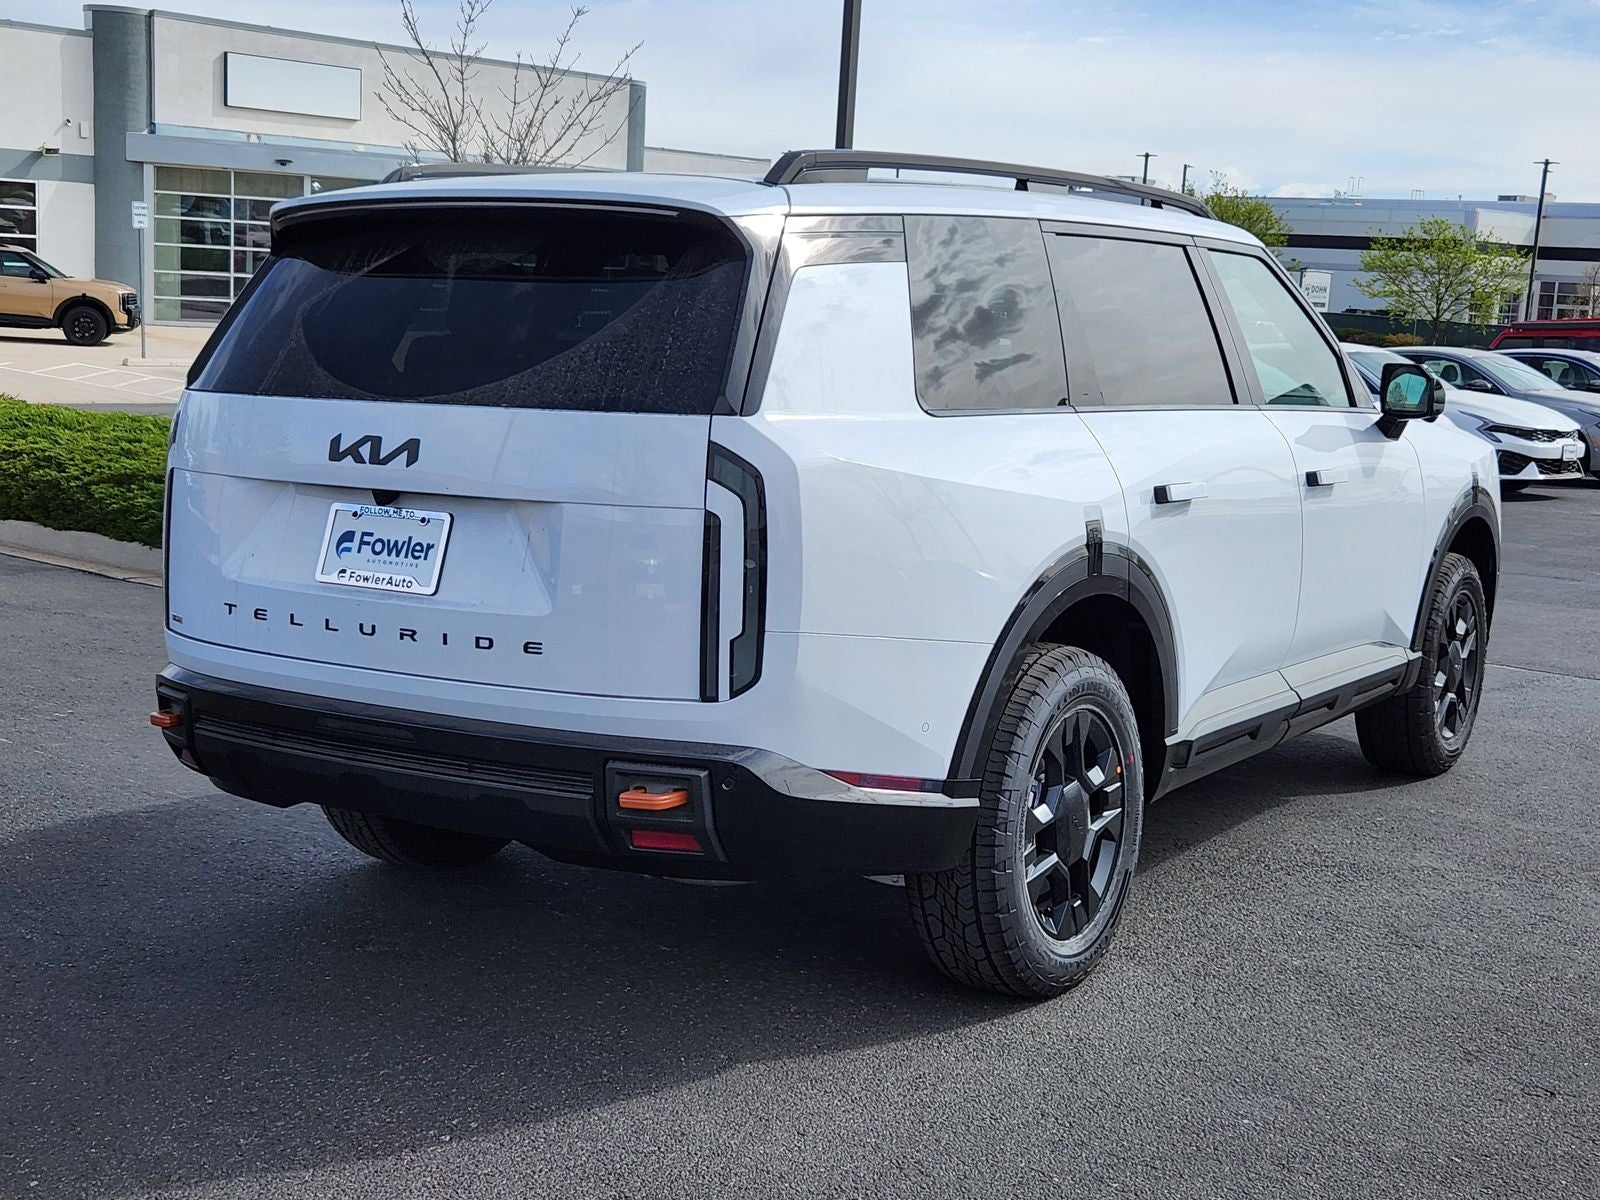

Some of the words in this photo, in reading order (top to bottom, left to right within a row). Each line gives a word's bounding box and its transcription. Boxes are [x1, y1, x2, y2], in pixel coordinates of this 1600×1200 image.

[328, 432, 421, 468] KIA
[360, 506, 393, 516] FOLLOW
[393, 508, 403, 517] ME
[357, 531, 435, 561] Fowler
[366, 558, 419, 569] AUTOMOTIVE
[348, 571, 413, 589] FowlerAuto
[224, 602, 543, 656] TELLURIDE
